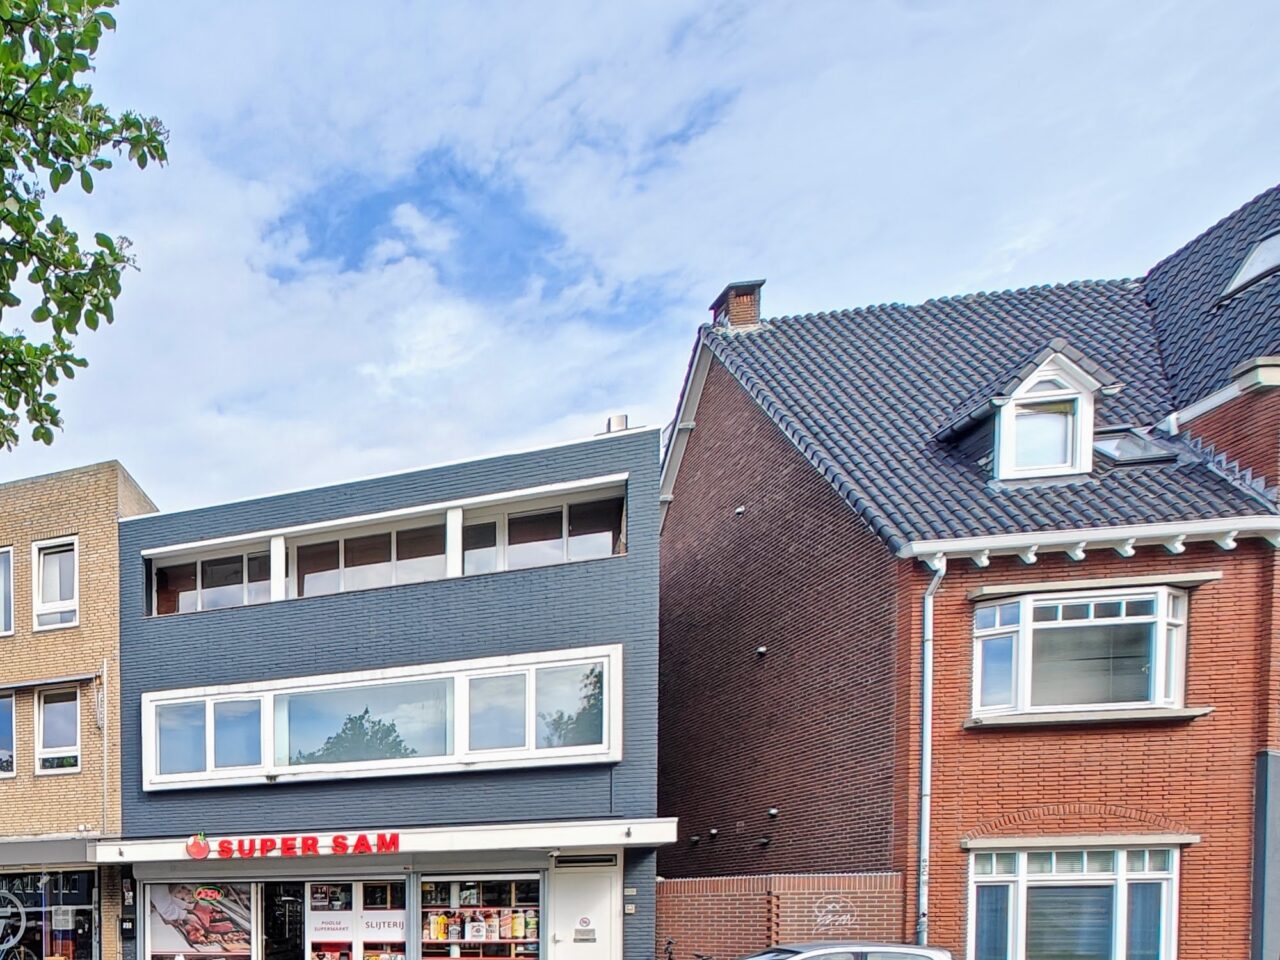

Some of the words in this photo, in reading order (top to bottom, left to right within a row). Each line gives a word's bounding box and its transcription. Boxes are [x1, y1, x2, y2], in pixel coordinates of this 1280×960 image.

[217, 837, 319, 859] SUPER
[331, 833, 400, 855] SAM
[365, 921, 405, 930] SLIJTERIJ
